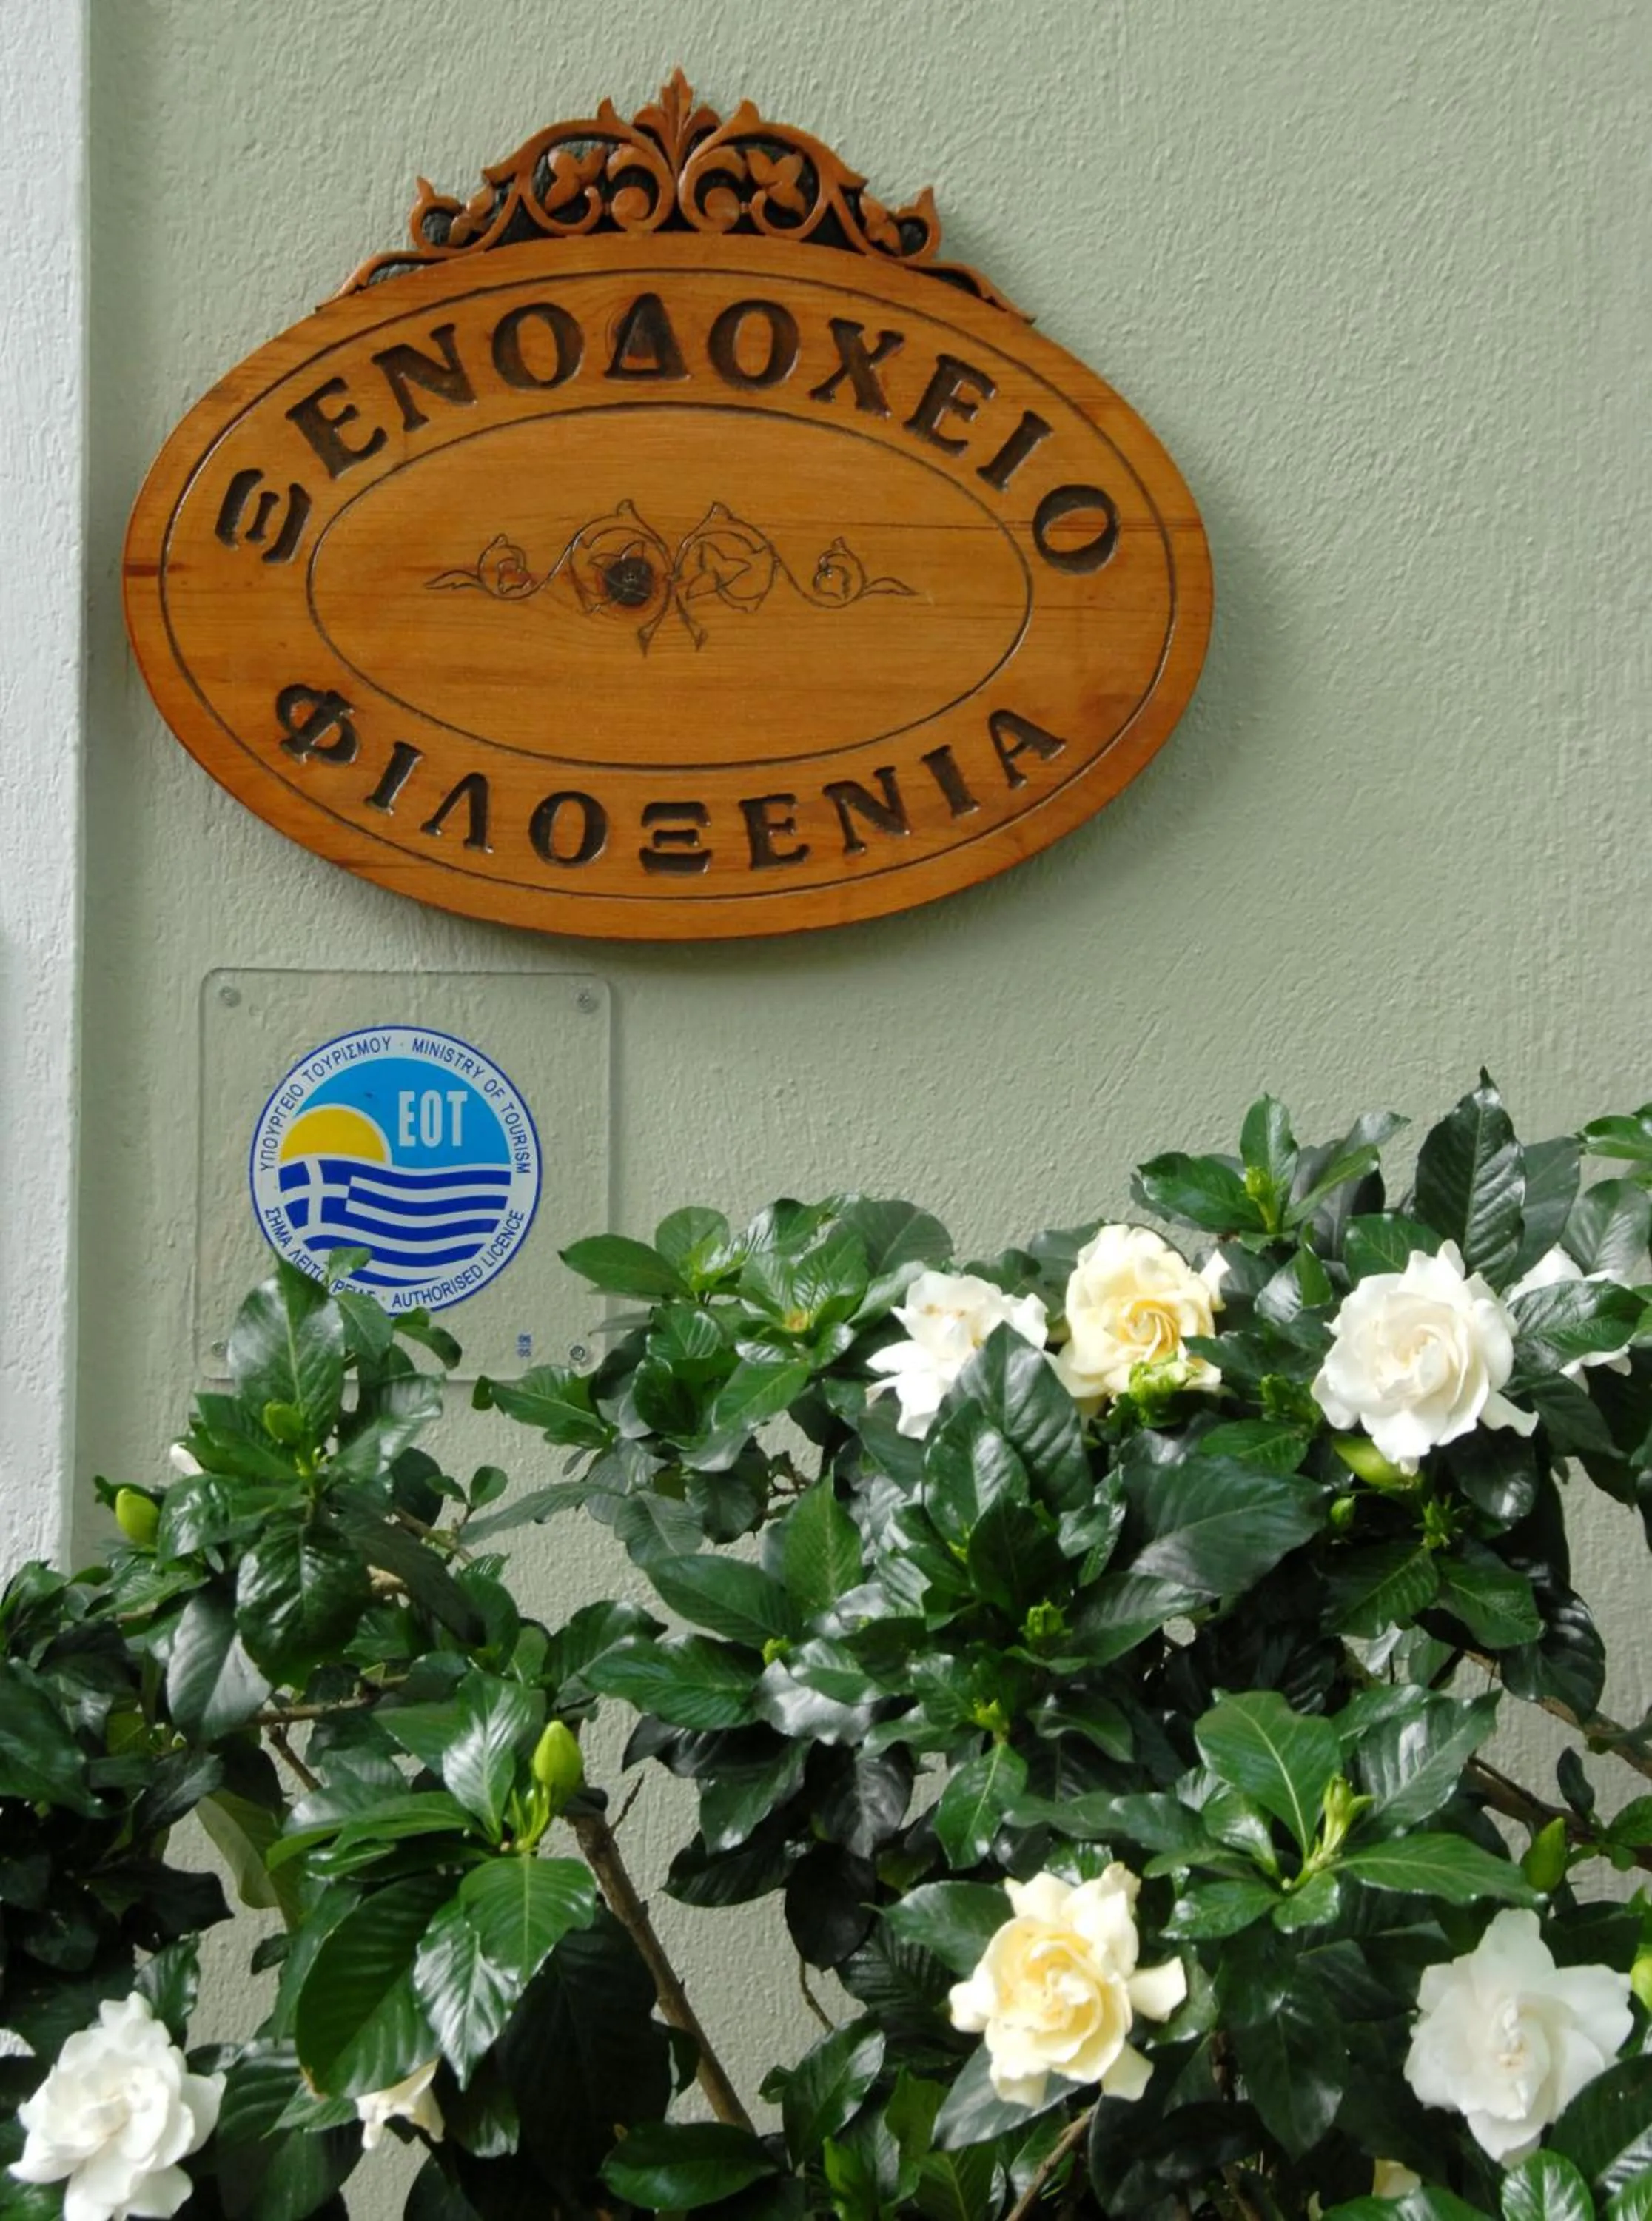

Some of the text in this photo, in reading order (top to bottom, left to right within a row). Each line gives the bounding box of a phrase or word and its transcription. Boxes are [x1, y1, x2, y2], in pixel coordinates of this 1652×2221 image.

[215, 294, 1120, 573] ΞΕΝΟΔΟΧΕΙΟ
[276, 684, 1066, 874] ΦΙΛΟΞΕΝΙΑ
[261, 1036, 391, 1171] ΥΠΟΥΡΓΕΙΟ ΤΟΥΡΙΣΜΟΥ
[412, 1037, 531, 1173] MINISTRY OF TOURISM
[264, 1207, 293, 1247] ΣΗΜΑ
[392, 1210, 524, 1308] AUTHORISED LICENCE
